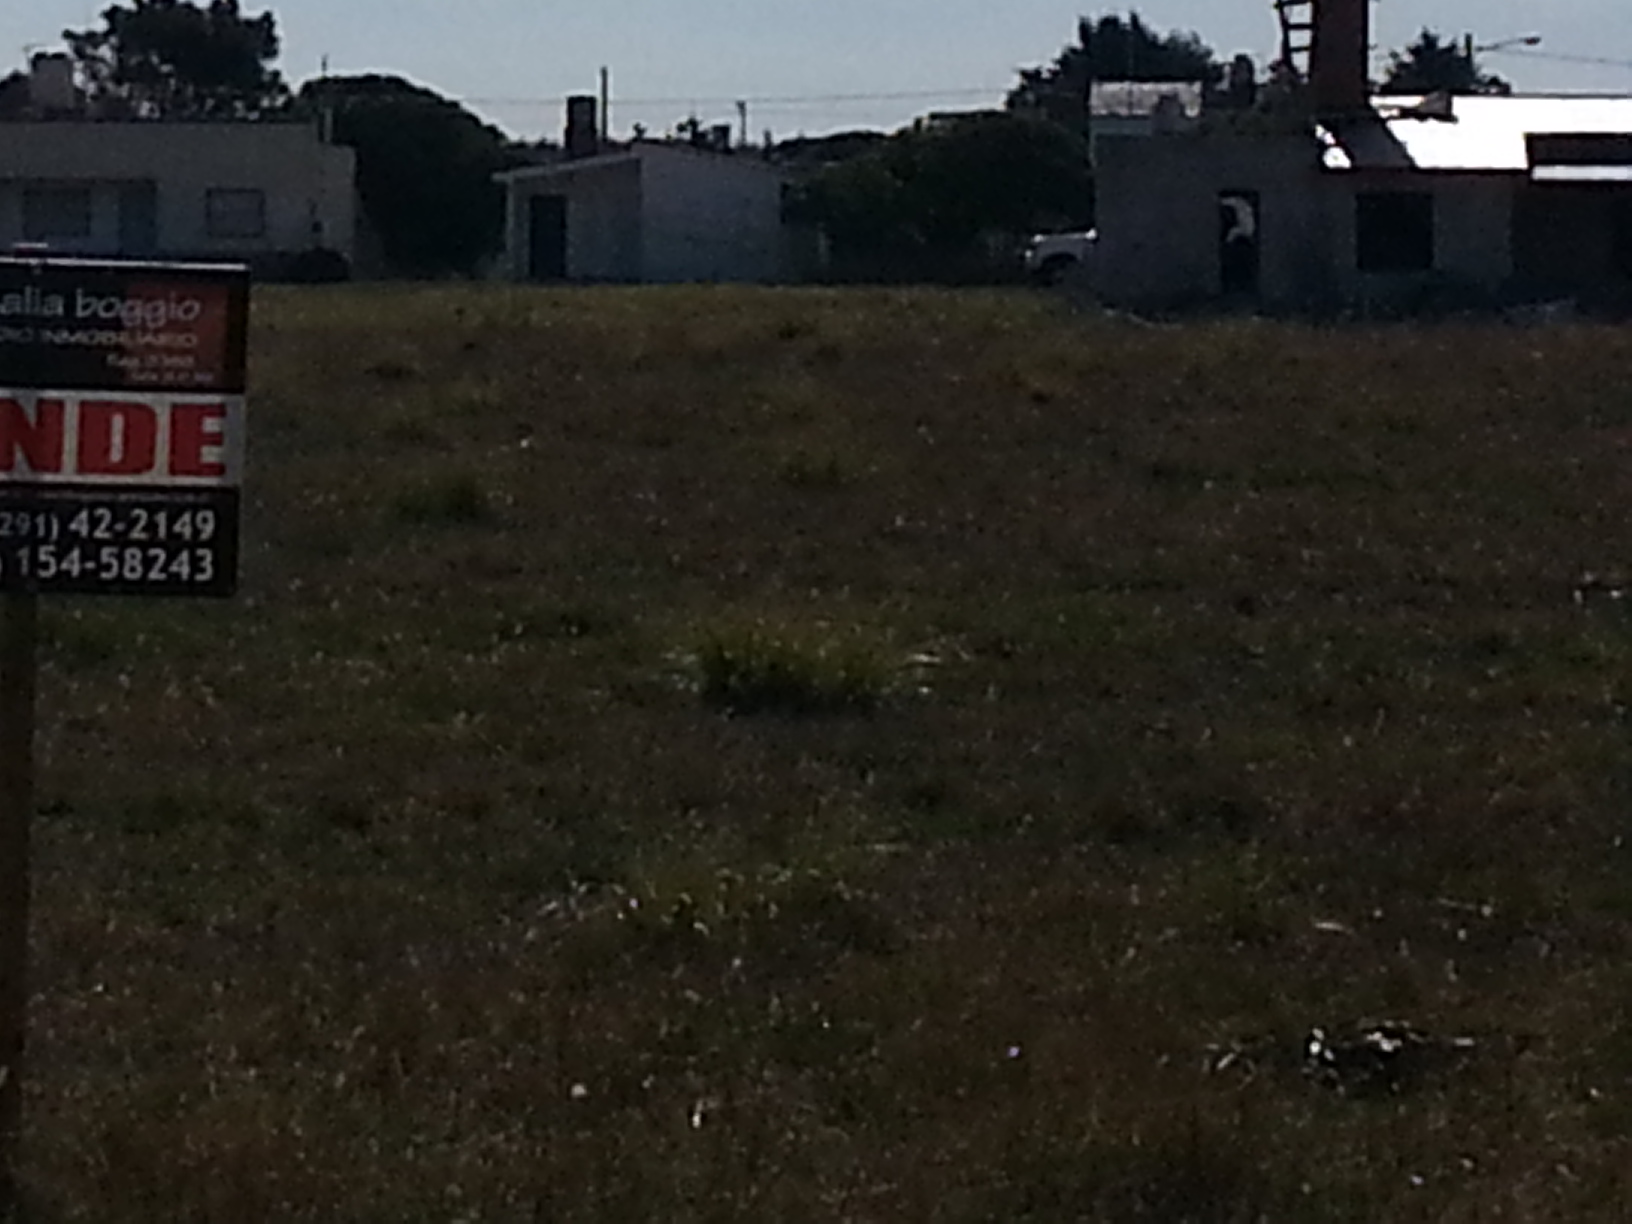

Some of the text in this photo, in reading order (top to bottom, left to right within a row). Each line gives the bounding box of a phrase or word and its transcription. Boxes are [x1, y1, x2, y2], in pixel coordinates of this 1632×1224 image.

[75, 287, 201, 328] boggio
[69, 508, 216, 540] 42-2149
[16, 544, 215, 581] 154-58243
